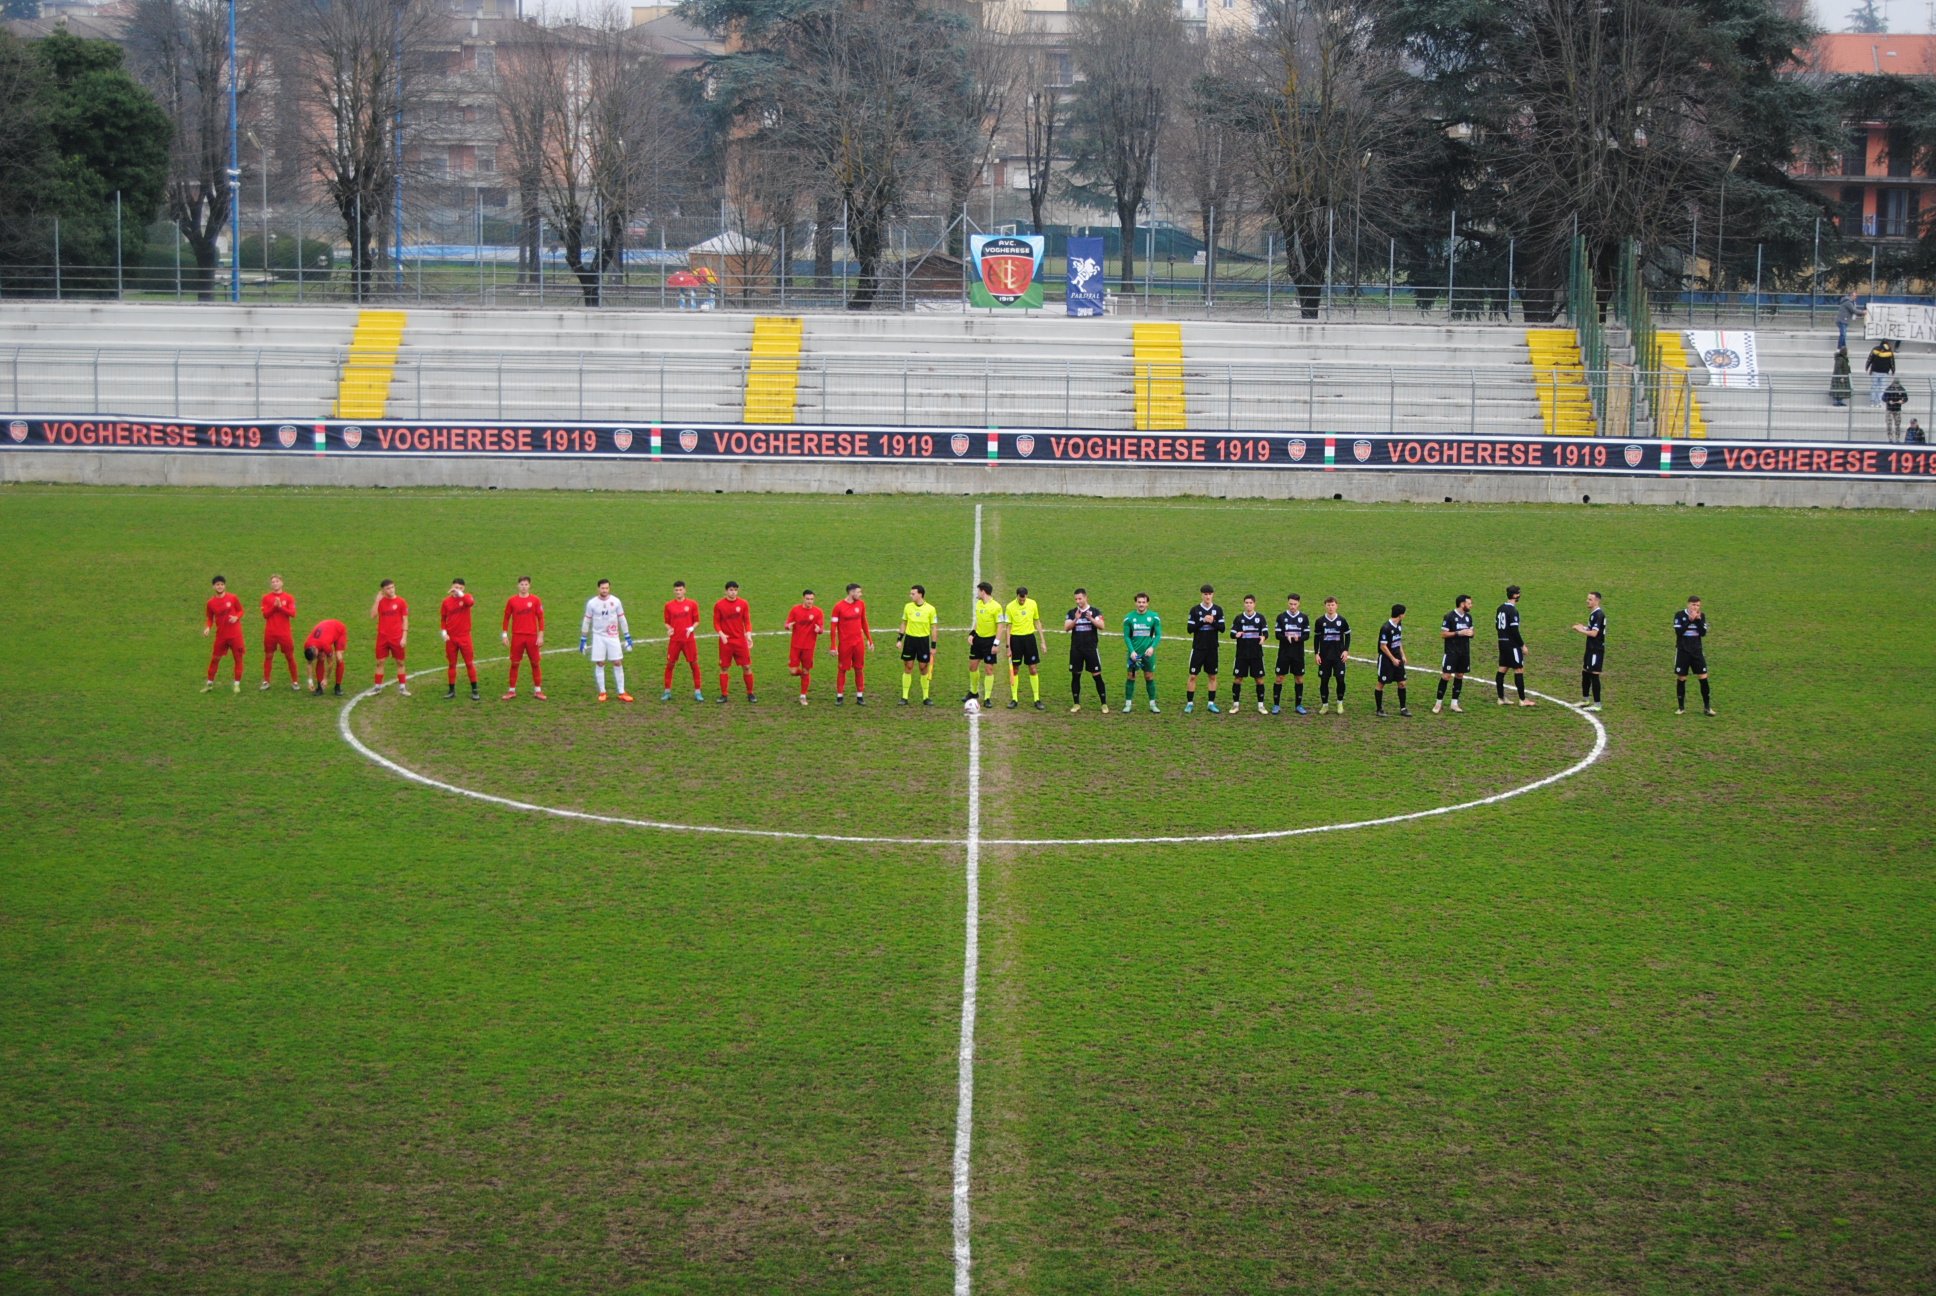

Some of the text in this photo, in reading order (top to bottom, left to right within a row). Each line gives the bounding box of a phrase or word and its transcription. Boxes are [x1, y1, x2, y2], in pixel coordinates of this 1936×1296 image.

[1867, 323, 1906, 338] EDIRE
[1910, 324, 1924, 339] LA
[43, 422, 197, 446] VOGHERESE
[207, 426, 261, 447] 1919
[378, 428, 597, 451] VOGHERESE 1919
[713, 431, 934, 457] VOGHERESE 1919
[1050, 436, 1270, 461] VOGHERESE 1919
[1388, 442, 1607, 467] VOGHERESE 1919
[1723, 448, 1878, 473] VOGHERESE
[1498, 612, 1506, 629] 19
